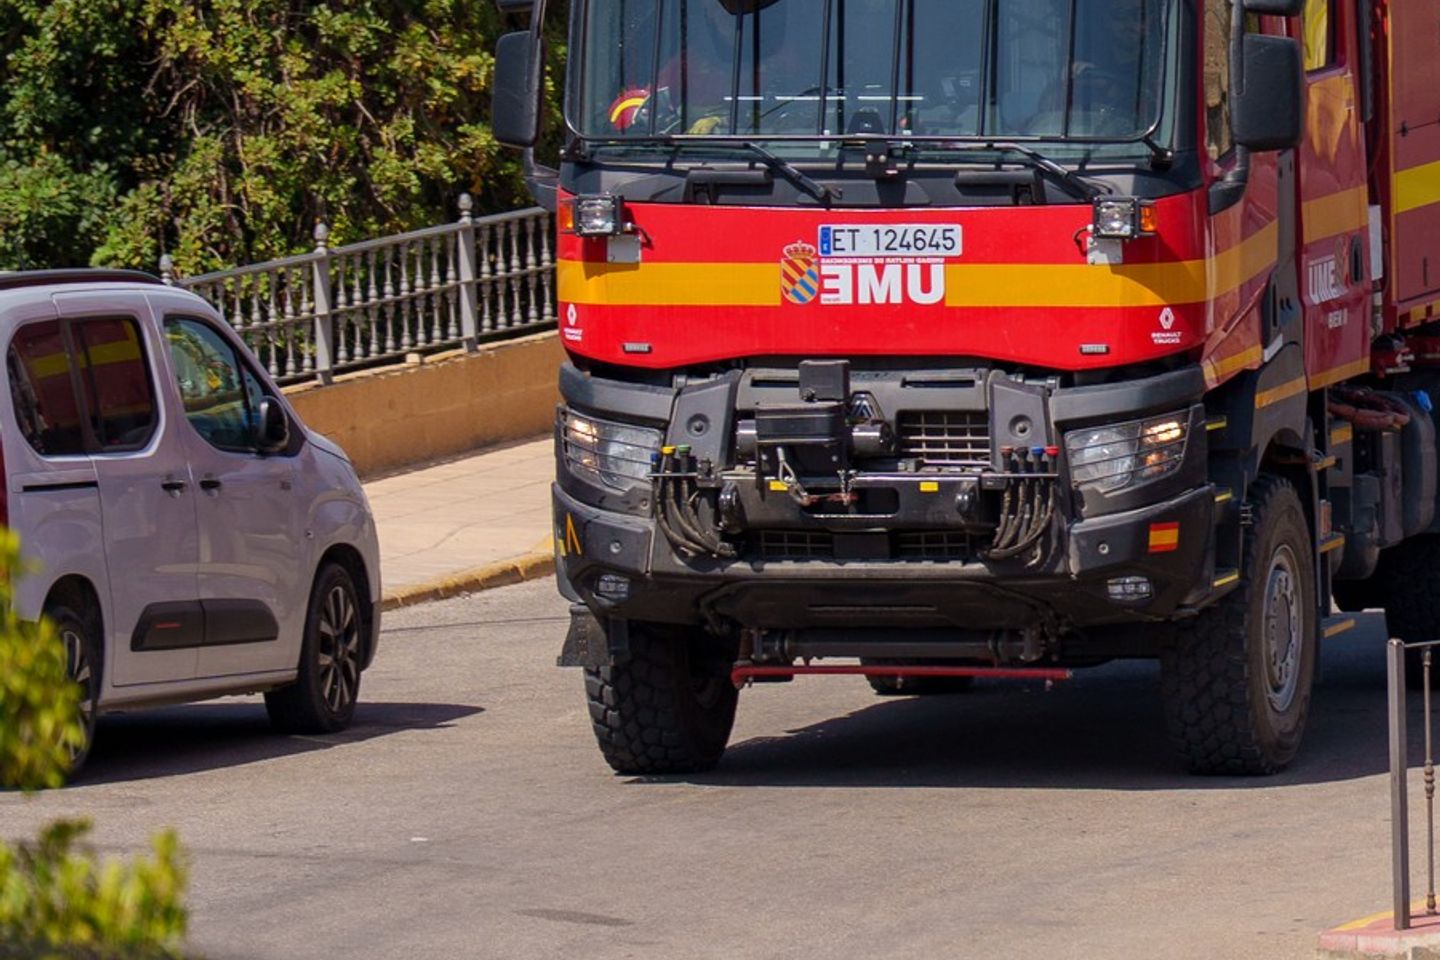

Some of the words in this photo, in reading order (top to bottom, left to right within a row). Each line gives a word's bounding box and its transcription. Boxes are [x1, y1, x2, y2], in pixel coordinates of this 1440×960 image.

[832, 229, 860, 251] ET
[874, 229, 956, 252] 124645
[1308, 260, 1336, 305] UME
